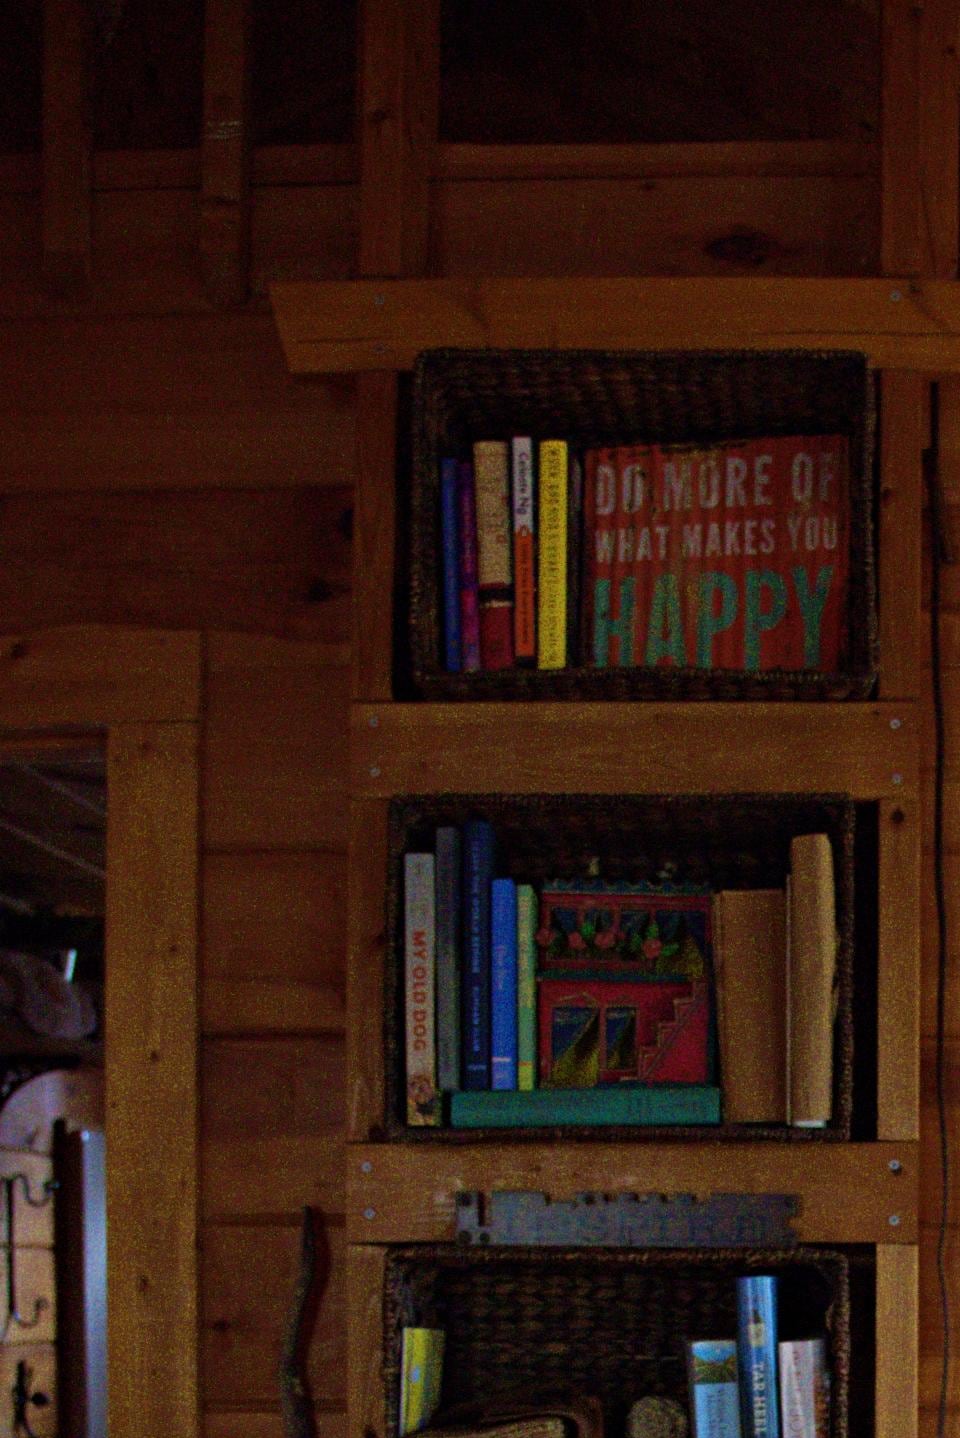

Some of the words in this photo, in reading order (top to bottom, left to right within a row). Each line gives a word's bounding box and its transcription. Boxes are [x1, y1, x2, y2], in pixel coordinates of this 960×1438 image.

[517, 452, 530, 493] Celeste
[596, 464, 645, 515] DO
[662, 452, 773, 513] MORE
[791, 452, 838, 502] OF
[514, 496, 530, 516] Ng
[596, 525, 671, 563] WHAT
[683, 517, 777, 557] MAKES
[787, 511, 838, 552] YOU
[594, 565, 834, 671] HAPPY
[412, 930, 427, 961] MY
[412, 965, 427, 1005] OLD
[412, 1009, 427, 1052] DOG
[752, 1361, 766, 1391] TAR
[753, 1395, 767, 1434] HEEL
